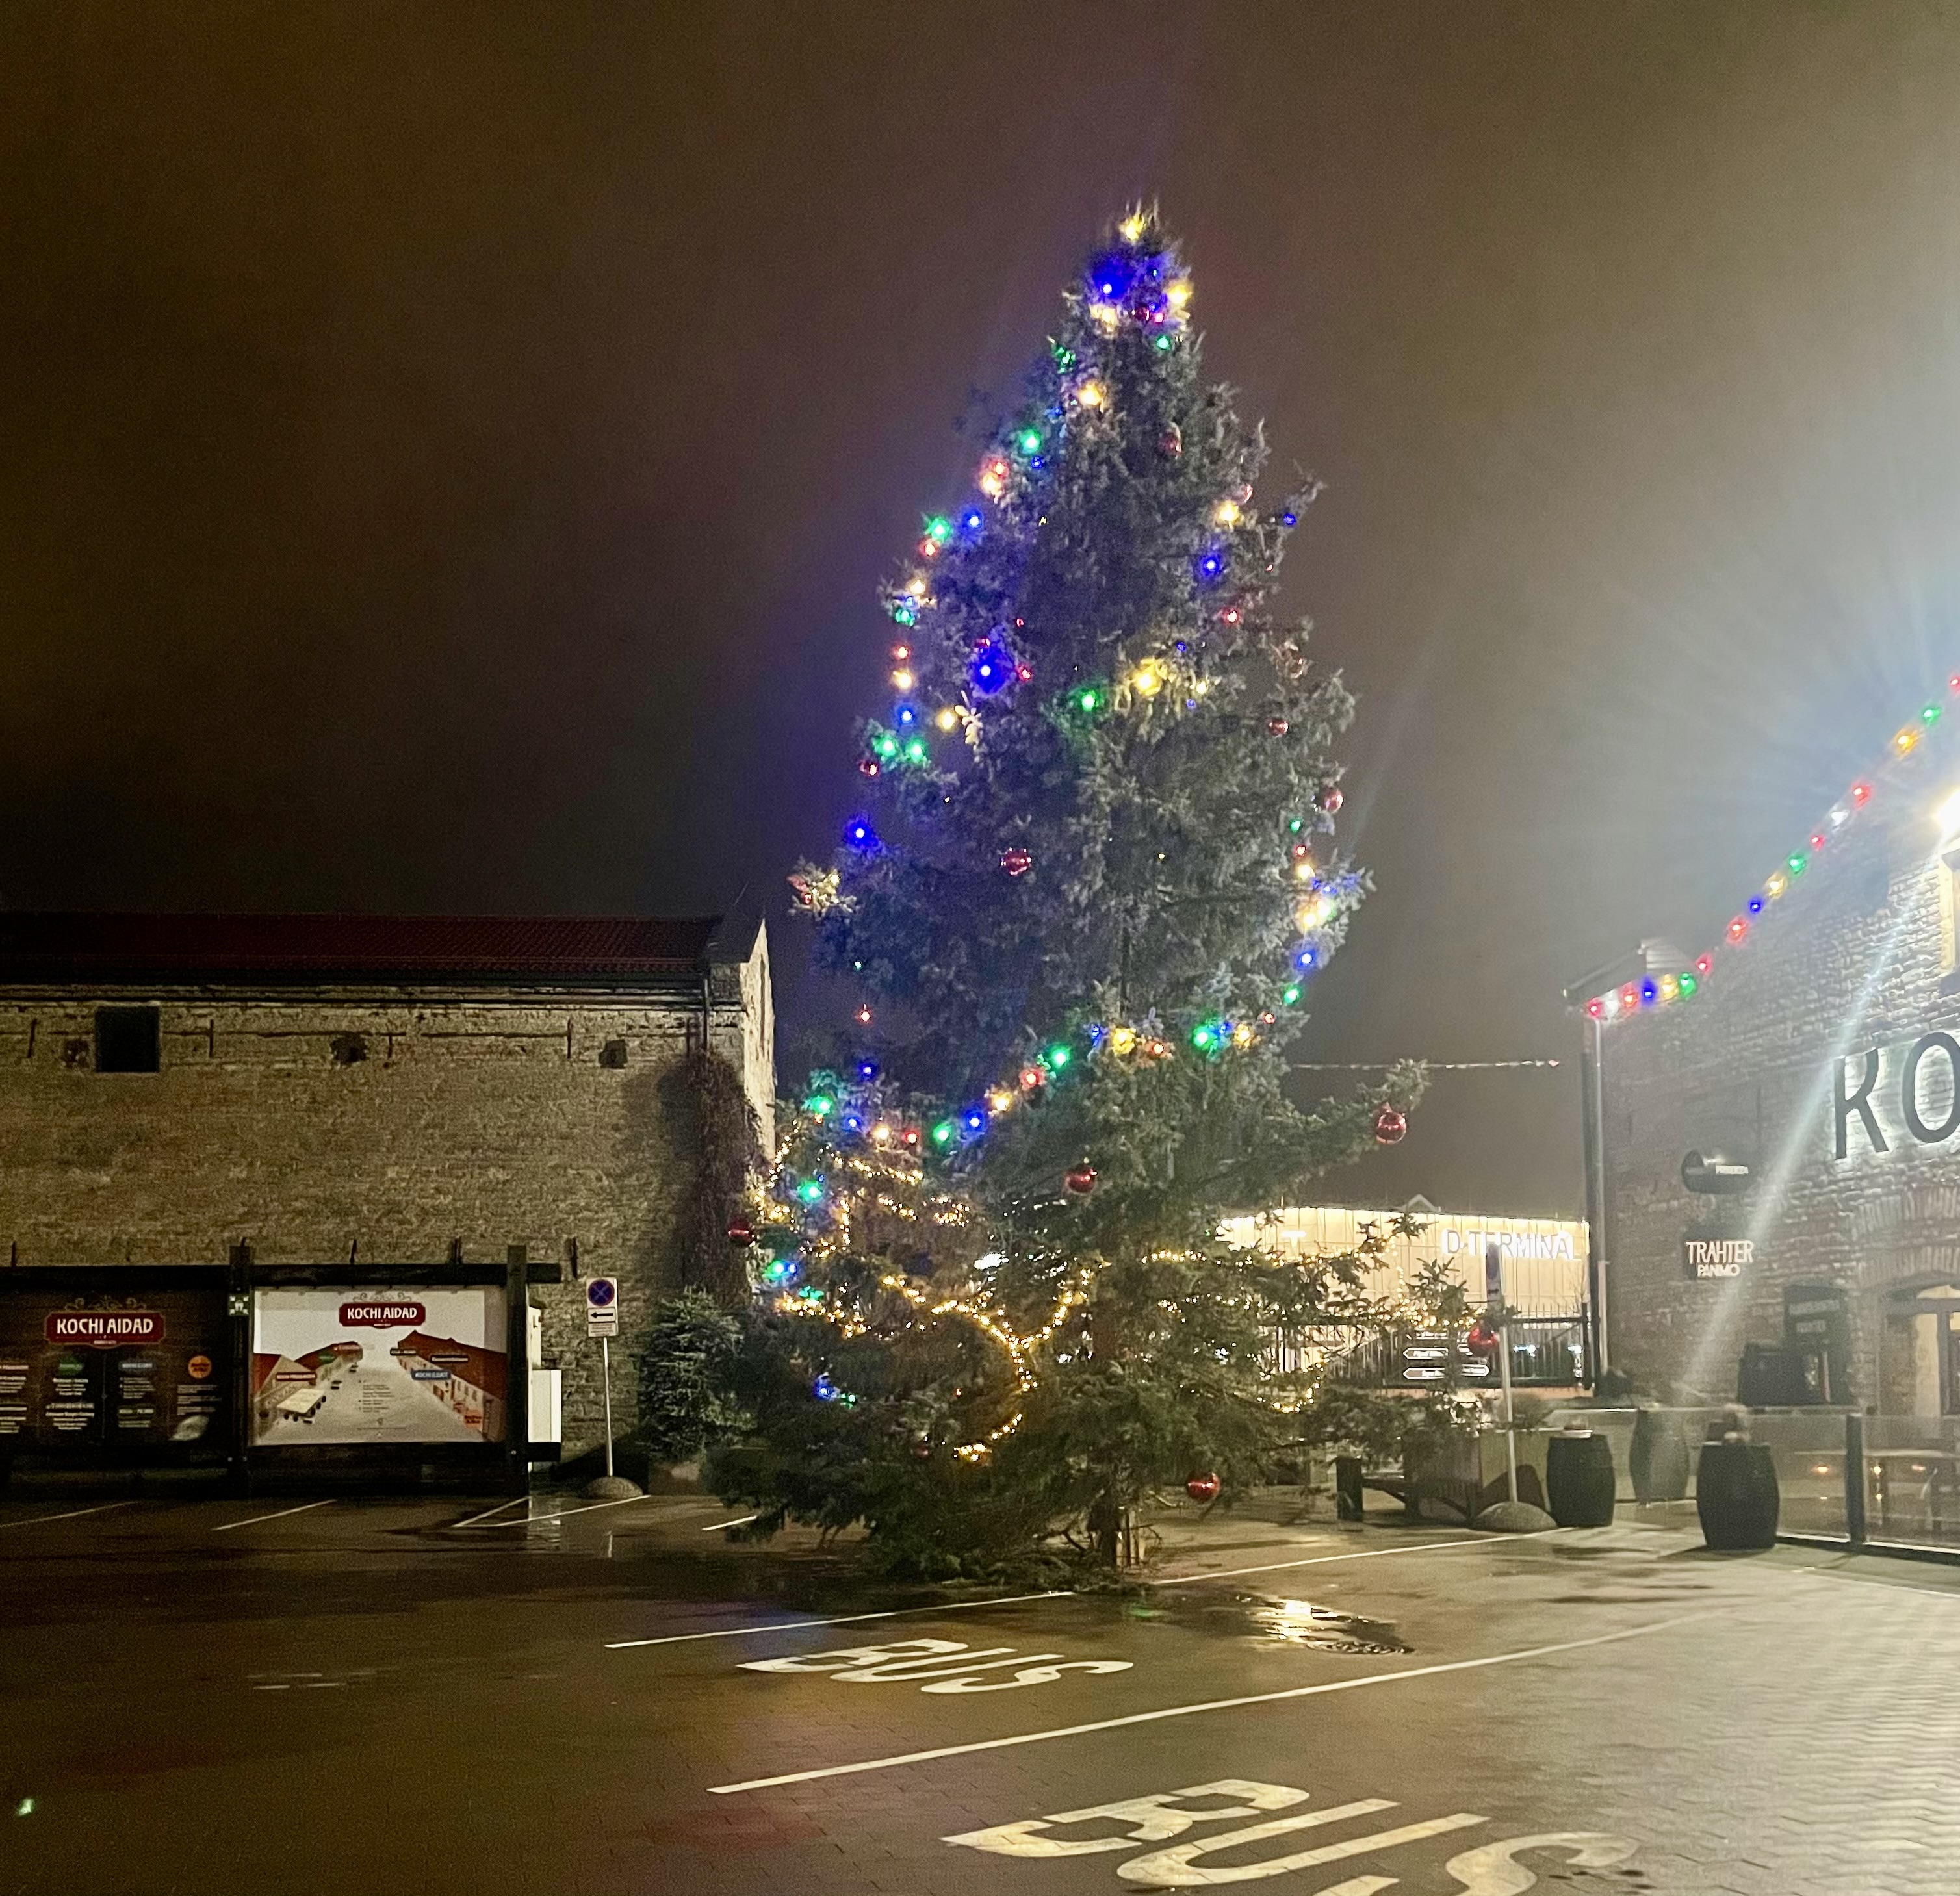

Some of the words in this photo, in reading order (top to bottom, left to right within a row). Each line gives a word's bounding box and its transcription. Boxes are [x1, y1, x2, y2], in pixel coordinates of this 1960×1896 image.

[1685, 1240, 1754, 1264] TRAHTER
[347, 1307, 381, 1320] KOCHI
[383, 1307, 418, 1319] AIDAD
[57, 1318, 103, 1334] KOCHI
[107, 1318, 153, 1334] AIDAD
[734, 1638, 1134, 1693] BUS
[940, 1778, 1640, 1896] BUS
